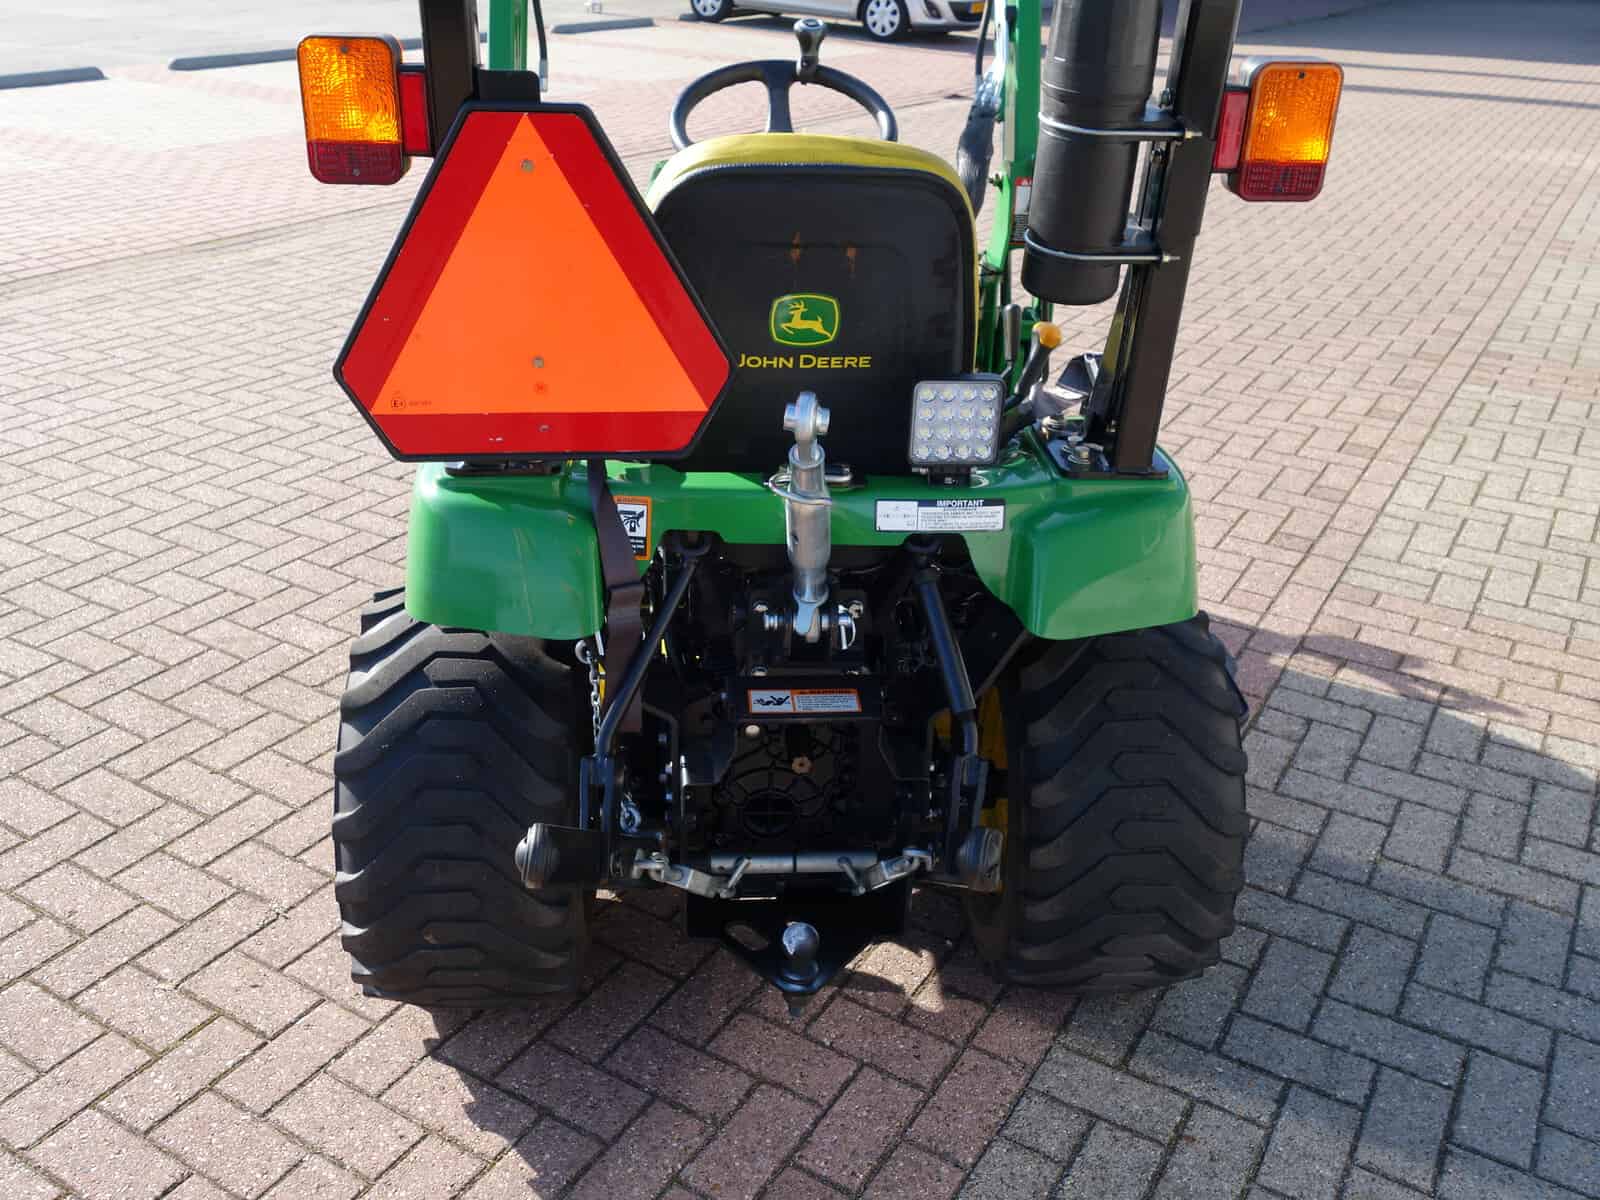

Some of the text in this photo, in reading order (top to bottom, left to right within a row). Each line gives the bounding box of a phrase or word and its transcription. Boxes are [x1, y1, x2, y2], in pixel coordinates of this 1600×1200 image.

[738, 353, 872, 368] JOHN DEERE
[936, 499, 985, 508] IMPORTANT
